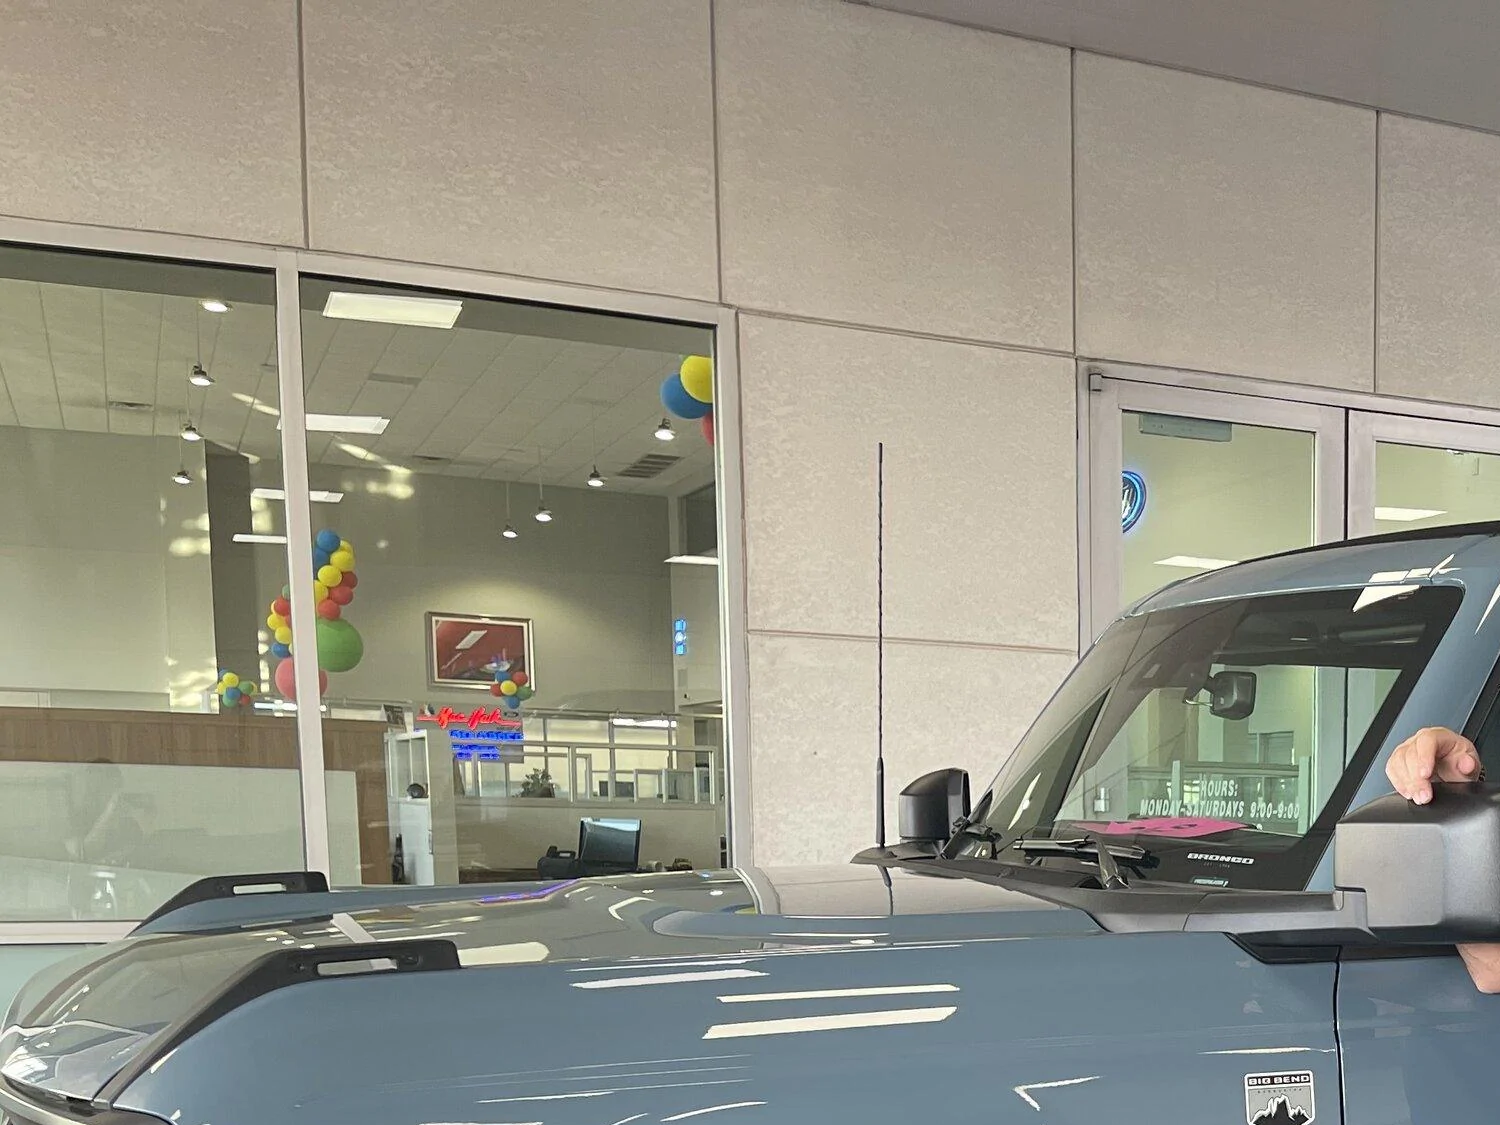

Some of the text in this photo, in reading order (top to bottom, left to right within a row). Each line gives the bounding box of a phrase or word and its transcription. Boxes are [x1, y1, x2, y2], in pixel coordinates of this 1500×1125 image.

[1200, 779, 1238, 798] HOURS:
[1139, 799, 1300, 820] MONDAY-SATURDAYS 9:00-9:00
[1187, 852, 1255, 865] BRONCO
[1248, 1075, 1310, 1086] BIG BEND
